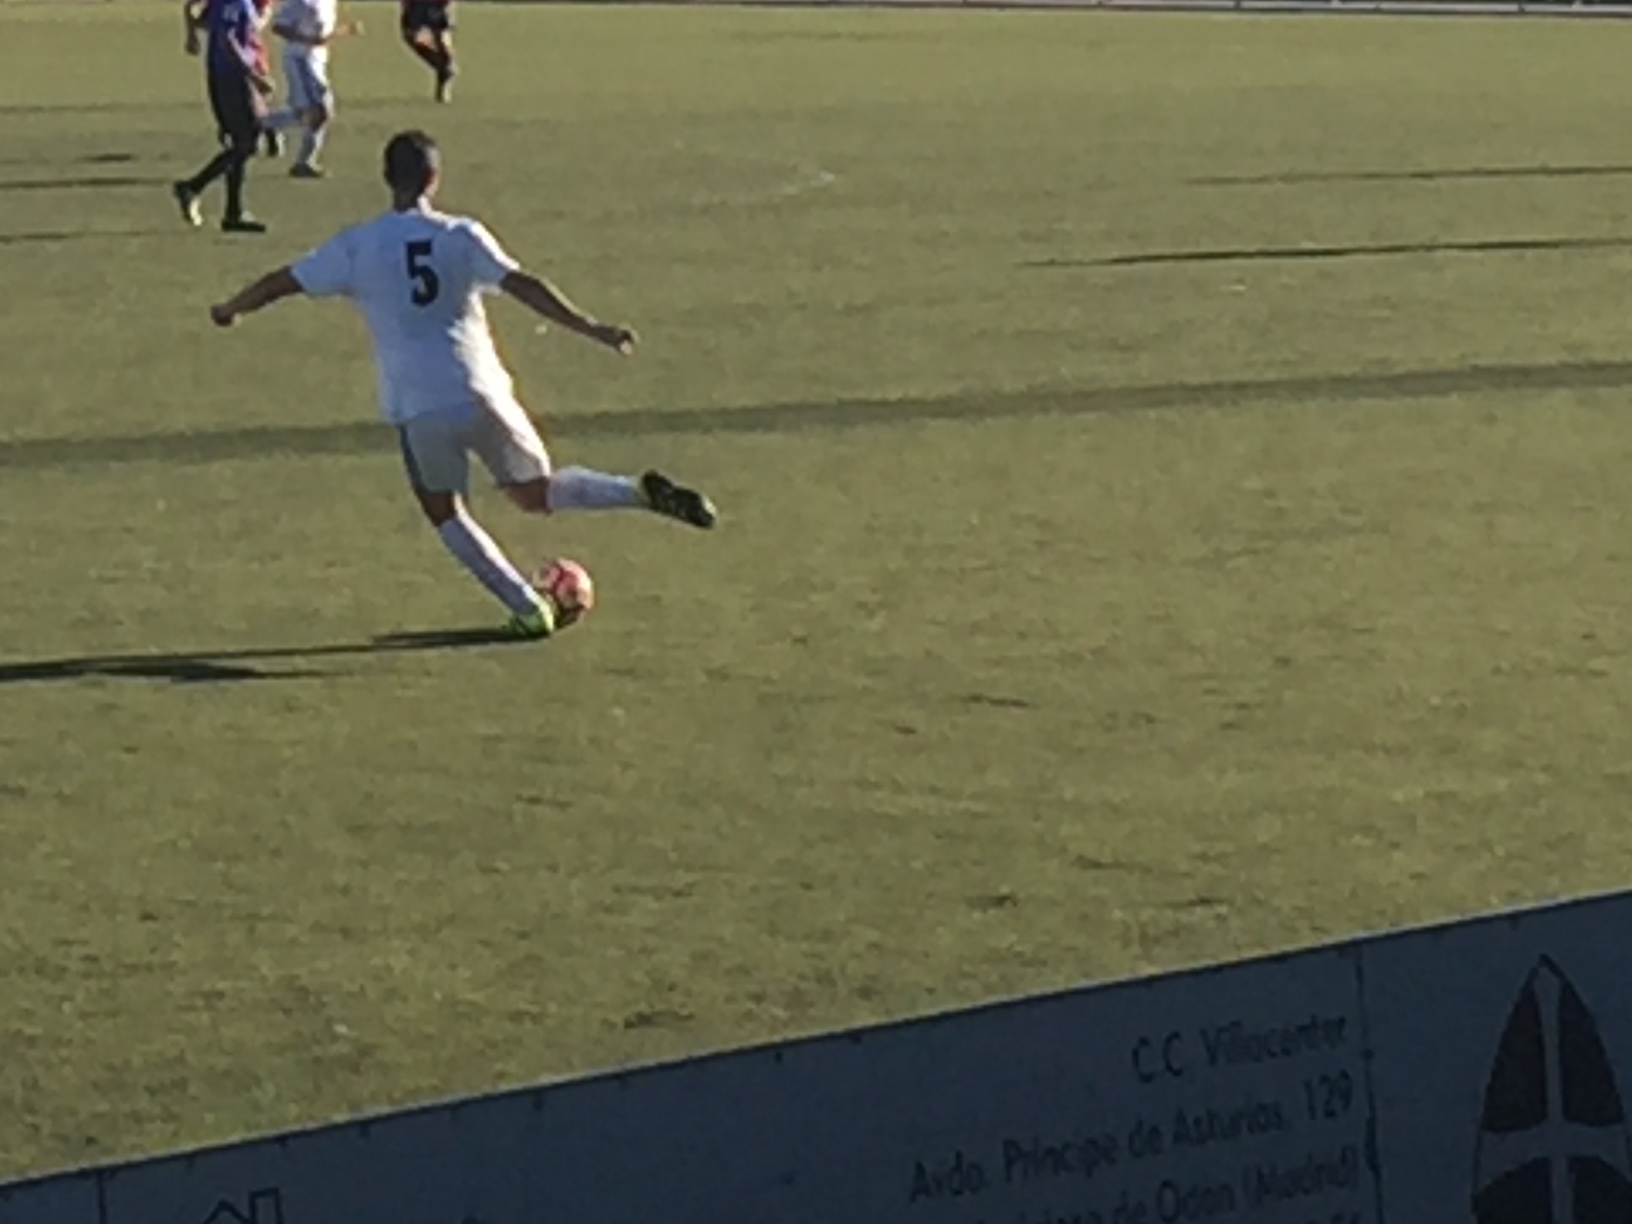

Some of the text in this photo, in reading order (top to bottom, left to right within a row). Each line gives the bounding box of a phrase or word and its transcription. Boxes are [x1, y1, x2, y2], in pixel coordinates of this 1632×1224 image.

[405, 239, 440, 306] 5
[1127, 1119, 1163, 1158] de
[1305, 1069, 1353, 1120] 129
